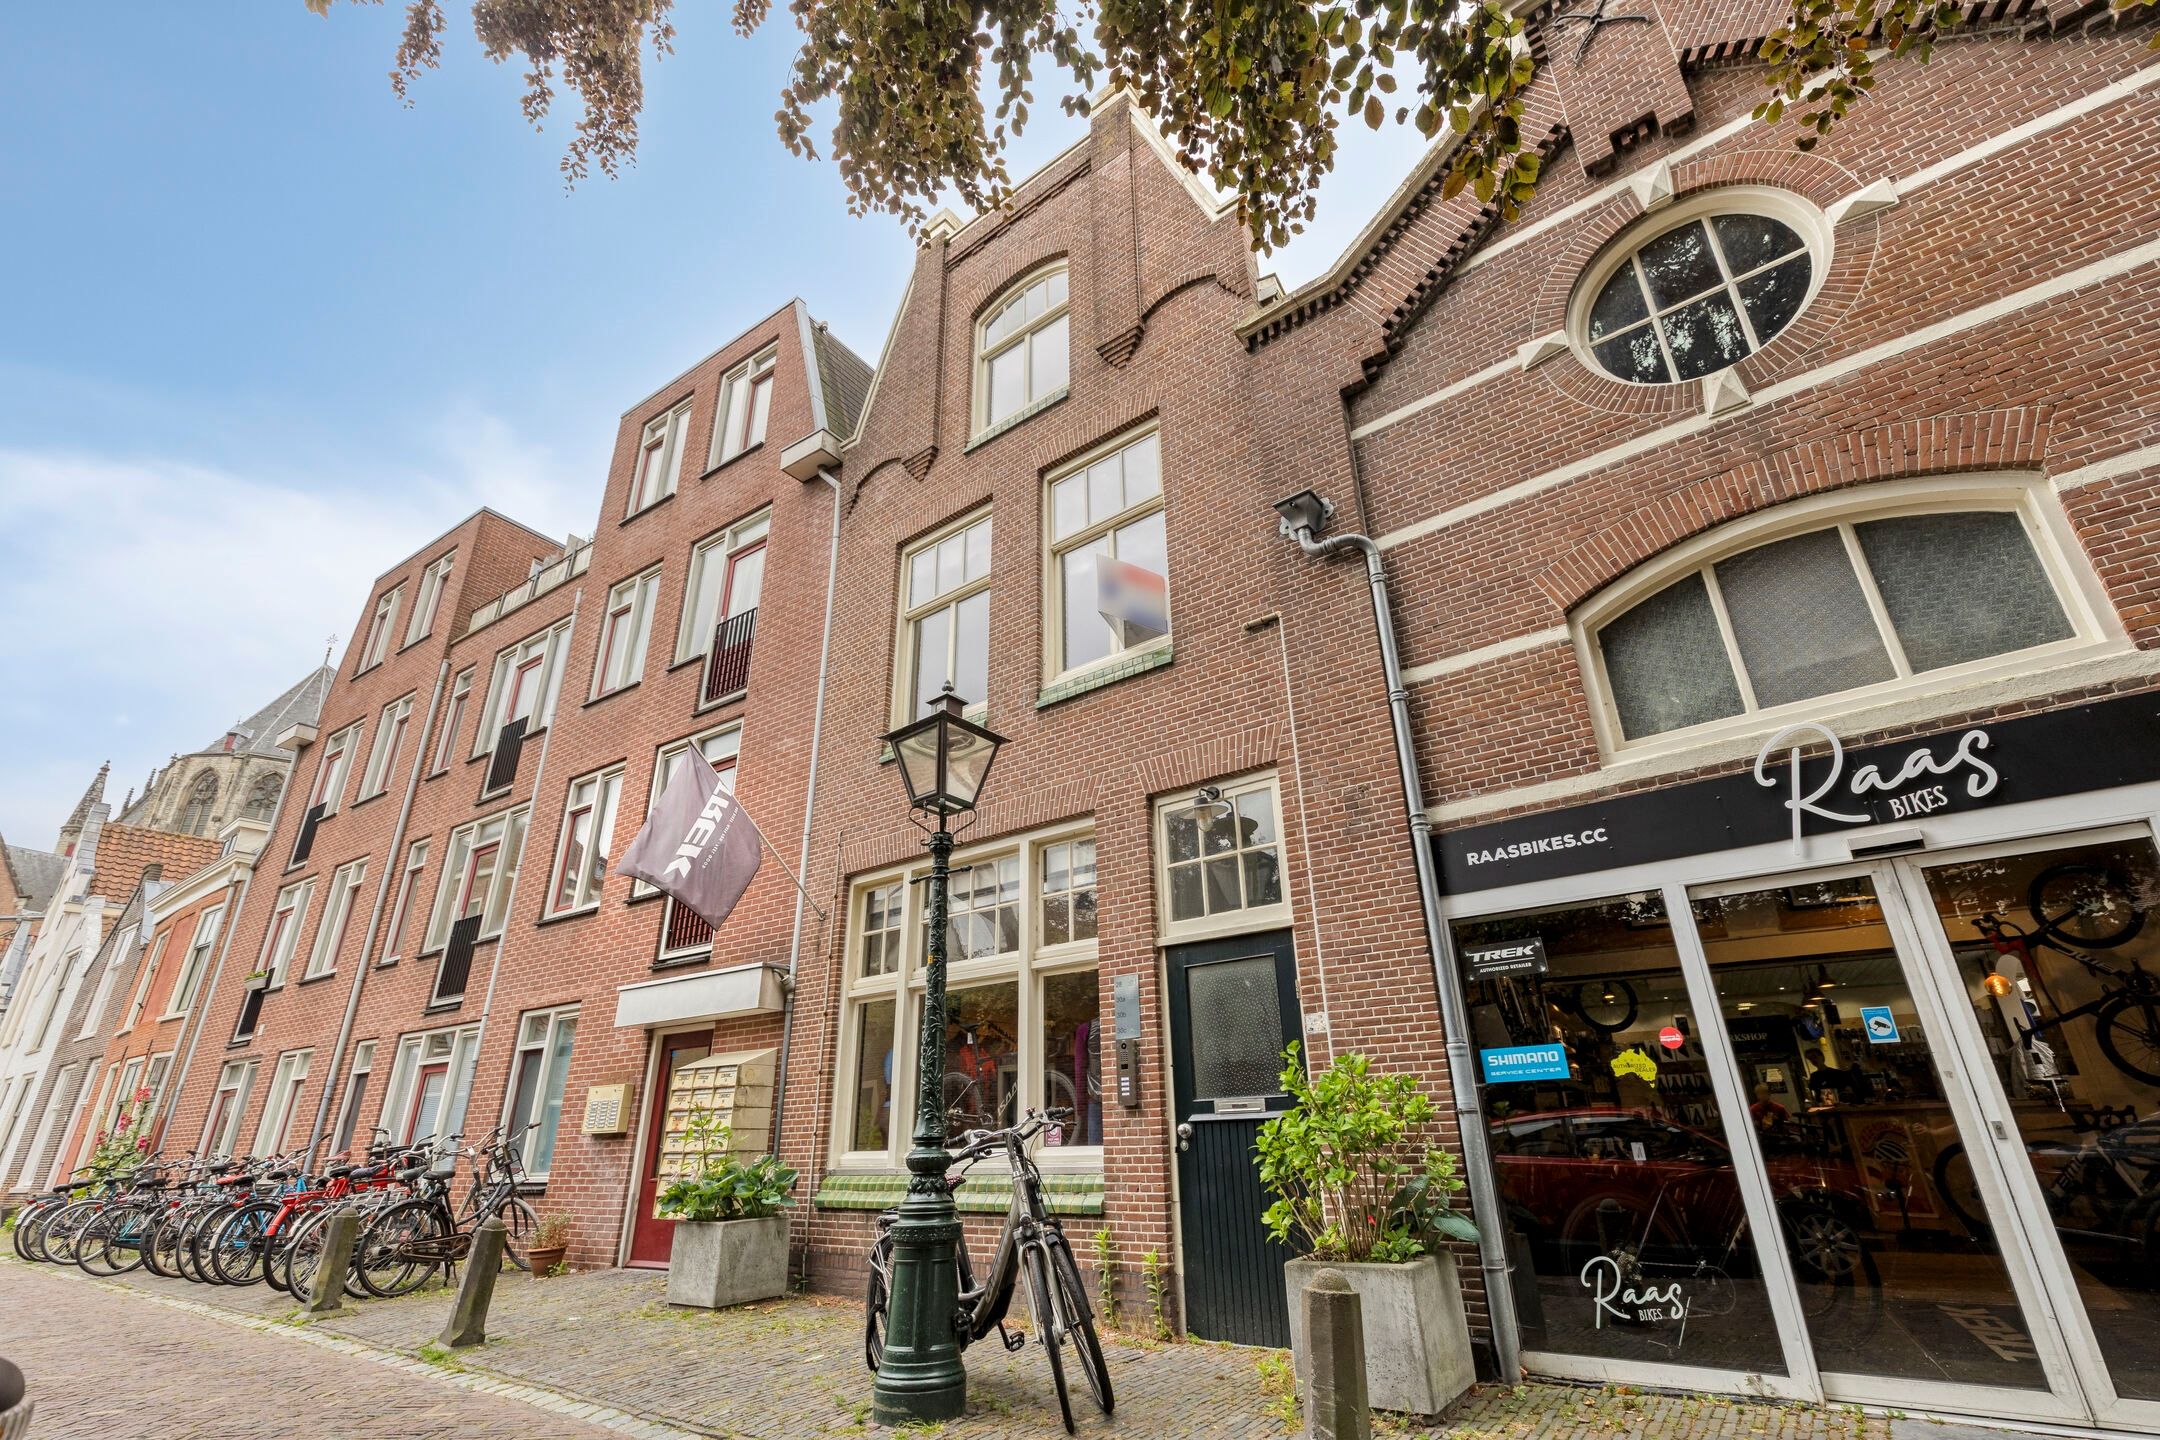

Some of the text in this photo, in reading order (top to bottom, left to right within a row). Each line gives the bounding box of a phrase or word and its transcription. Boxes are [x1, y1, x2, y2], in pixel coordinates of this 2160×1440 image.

[1754, 721, 1998, 856] Raas
[1888, 785, 1949, 819] BIKES
[1466, 828, 1608, 866] RAASBIKES.CC
[1466, 944, 1535, 963] TREK
[1480, 962, 1532, 974] AUTHORIZED RETAILER
[1487, 1050, 1559, 1067] SHIMANO
[1490, 1069, 1524, 1077] SERVICE
[1581, 1255, 1684, 1330] Raas
[1638, 1308, 1663, 1322] BIKES
